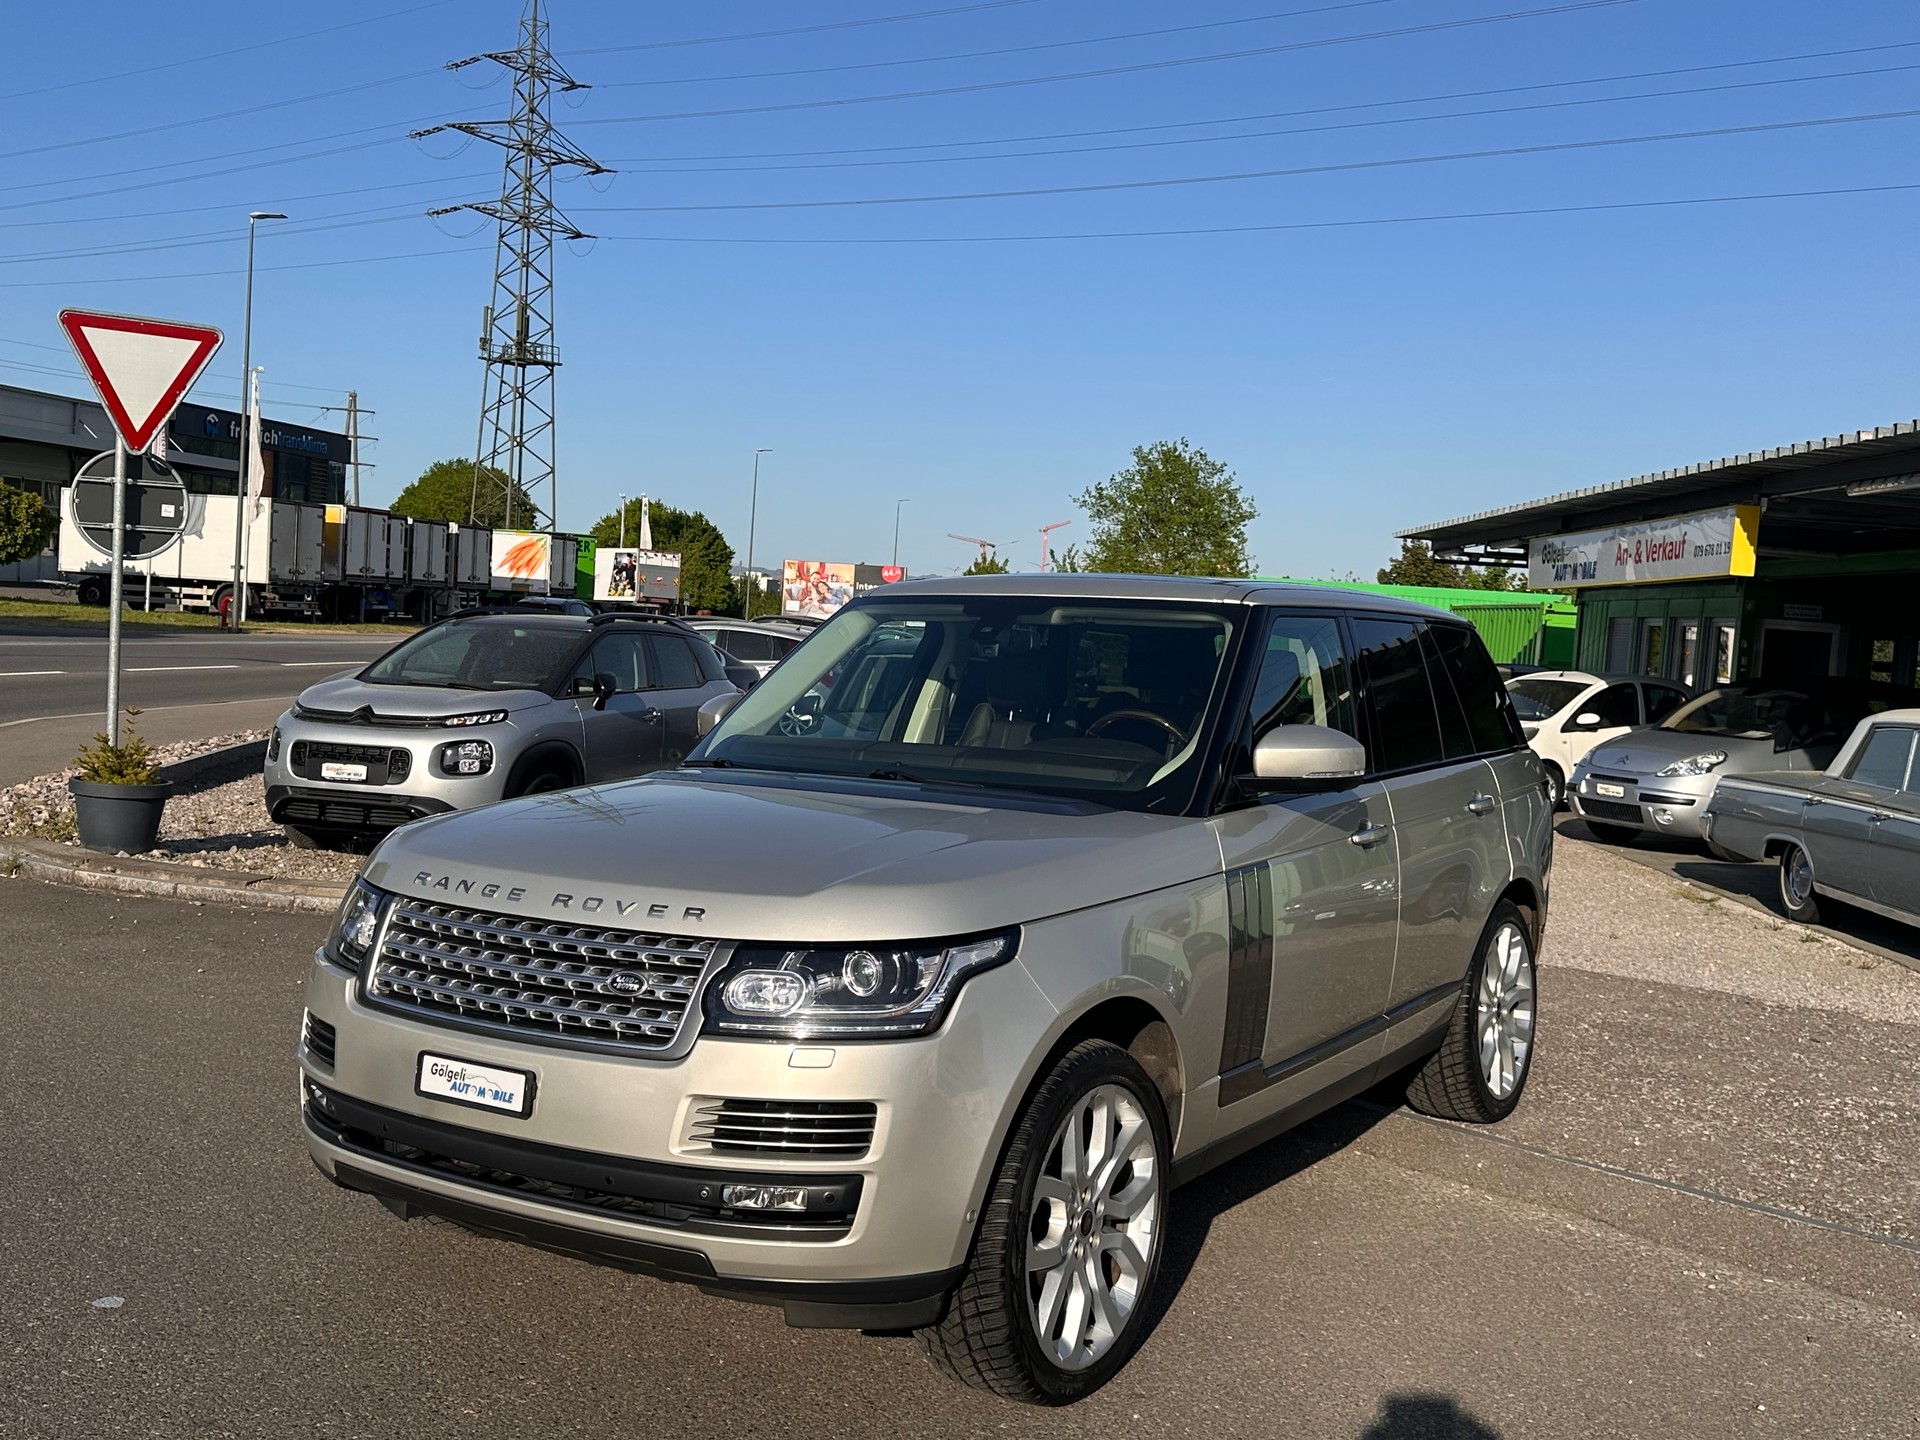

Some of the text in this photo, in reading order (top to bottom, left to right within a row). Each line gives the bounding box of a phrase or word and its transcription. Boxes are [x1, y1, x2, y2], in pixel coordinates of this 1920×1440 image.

[229, 420, 328, 455] frichtransklima
[1541, 541, 1565, 569] Gölgeli
[1615, 531, 1687, 566] An- & Verkauf
[1693, 541, 1731, 558] 079 678 01 19
[413, 871, 706, 922] RANGE ROVER
[430, 1062, 467, 1082] Gölgeli
